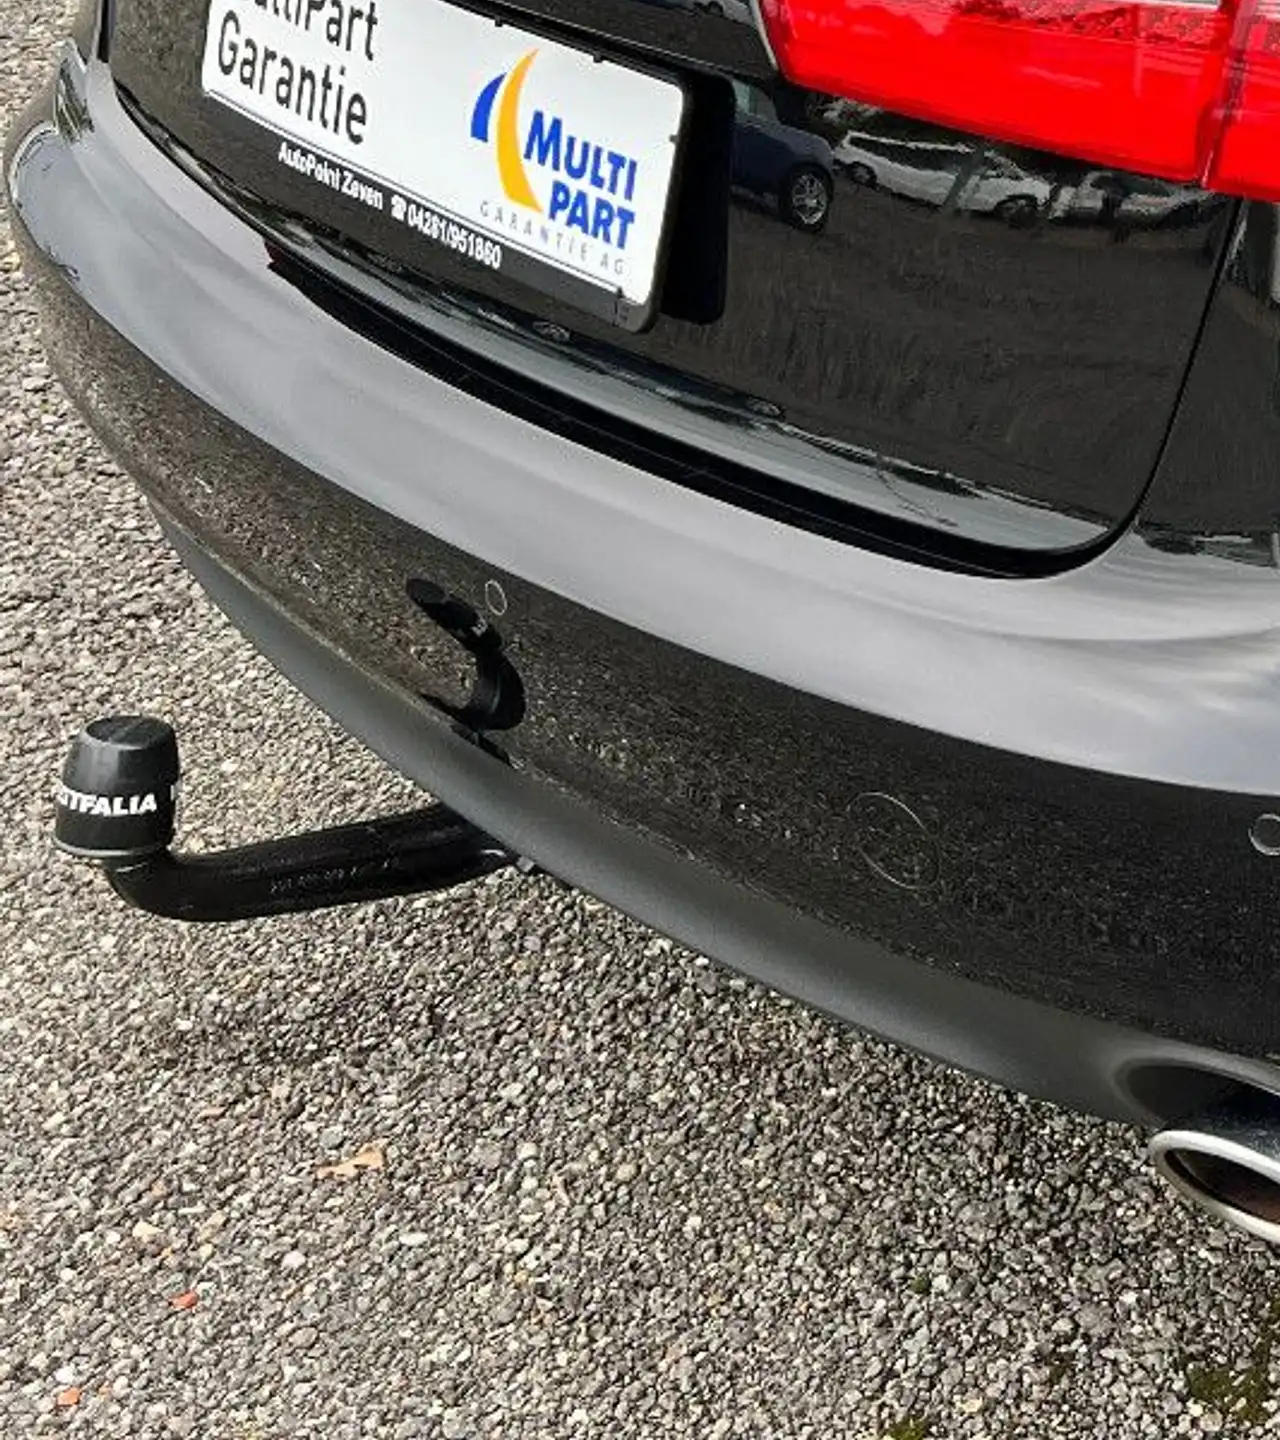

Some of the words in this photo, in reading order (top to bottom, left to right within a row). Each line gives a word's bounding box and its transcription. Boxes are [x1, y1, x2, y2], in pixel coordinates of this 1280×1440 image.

[218, 9, 367, 145] Garantie
[278, 141, 340, 191] AutoPoint
[341, 169, 384, 210] Zeven
[523, 109, 637, 201] MULTI
[480, 200, 588, 262] GARANTIE
[600, 251, 626, 275] AG
[548, 179, 636, 250] PART
